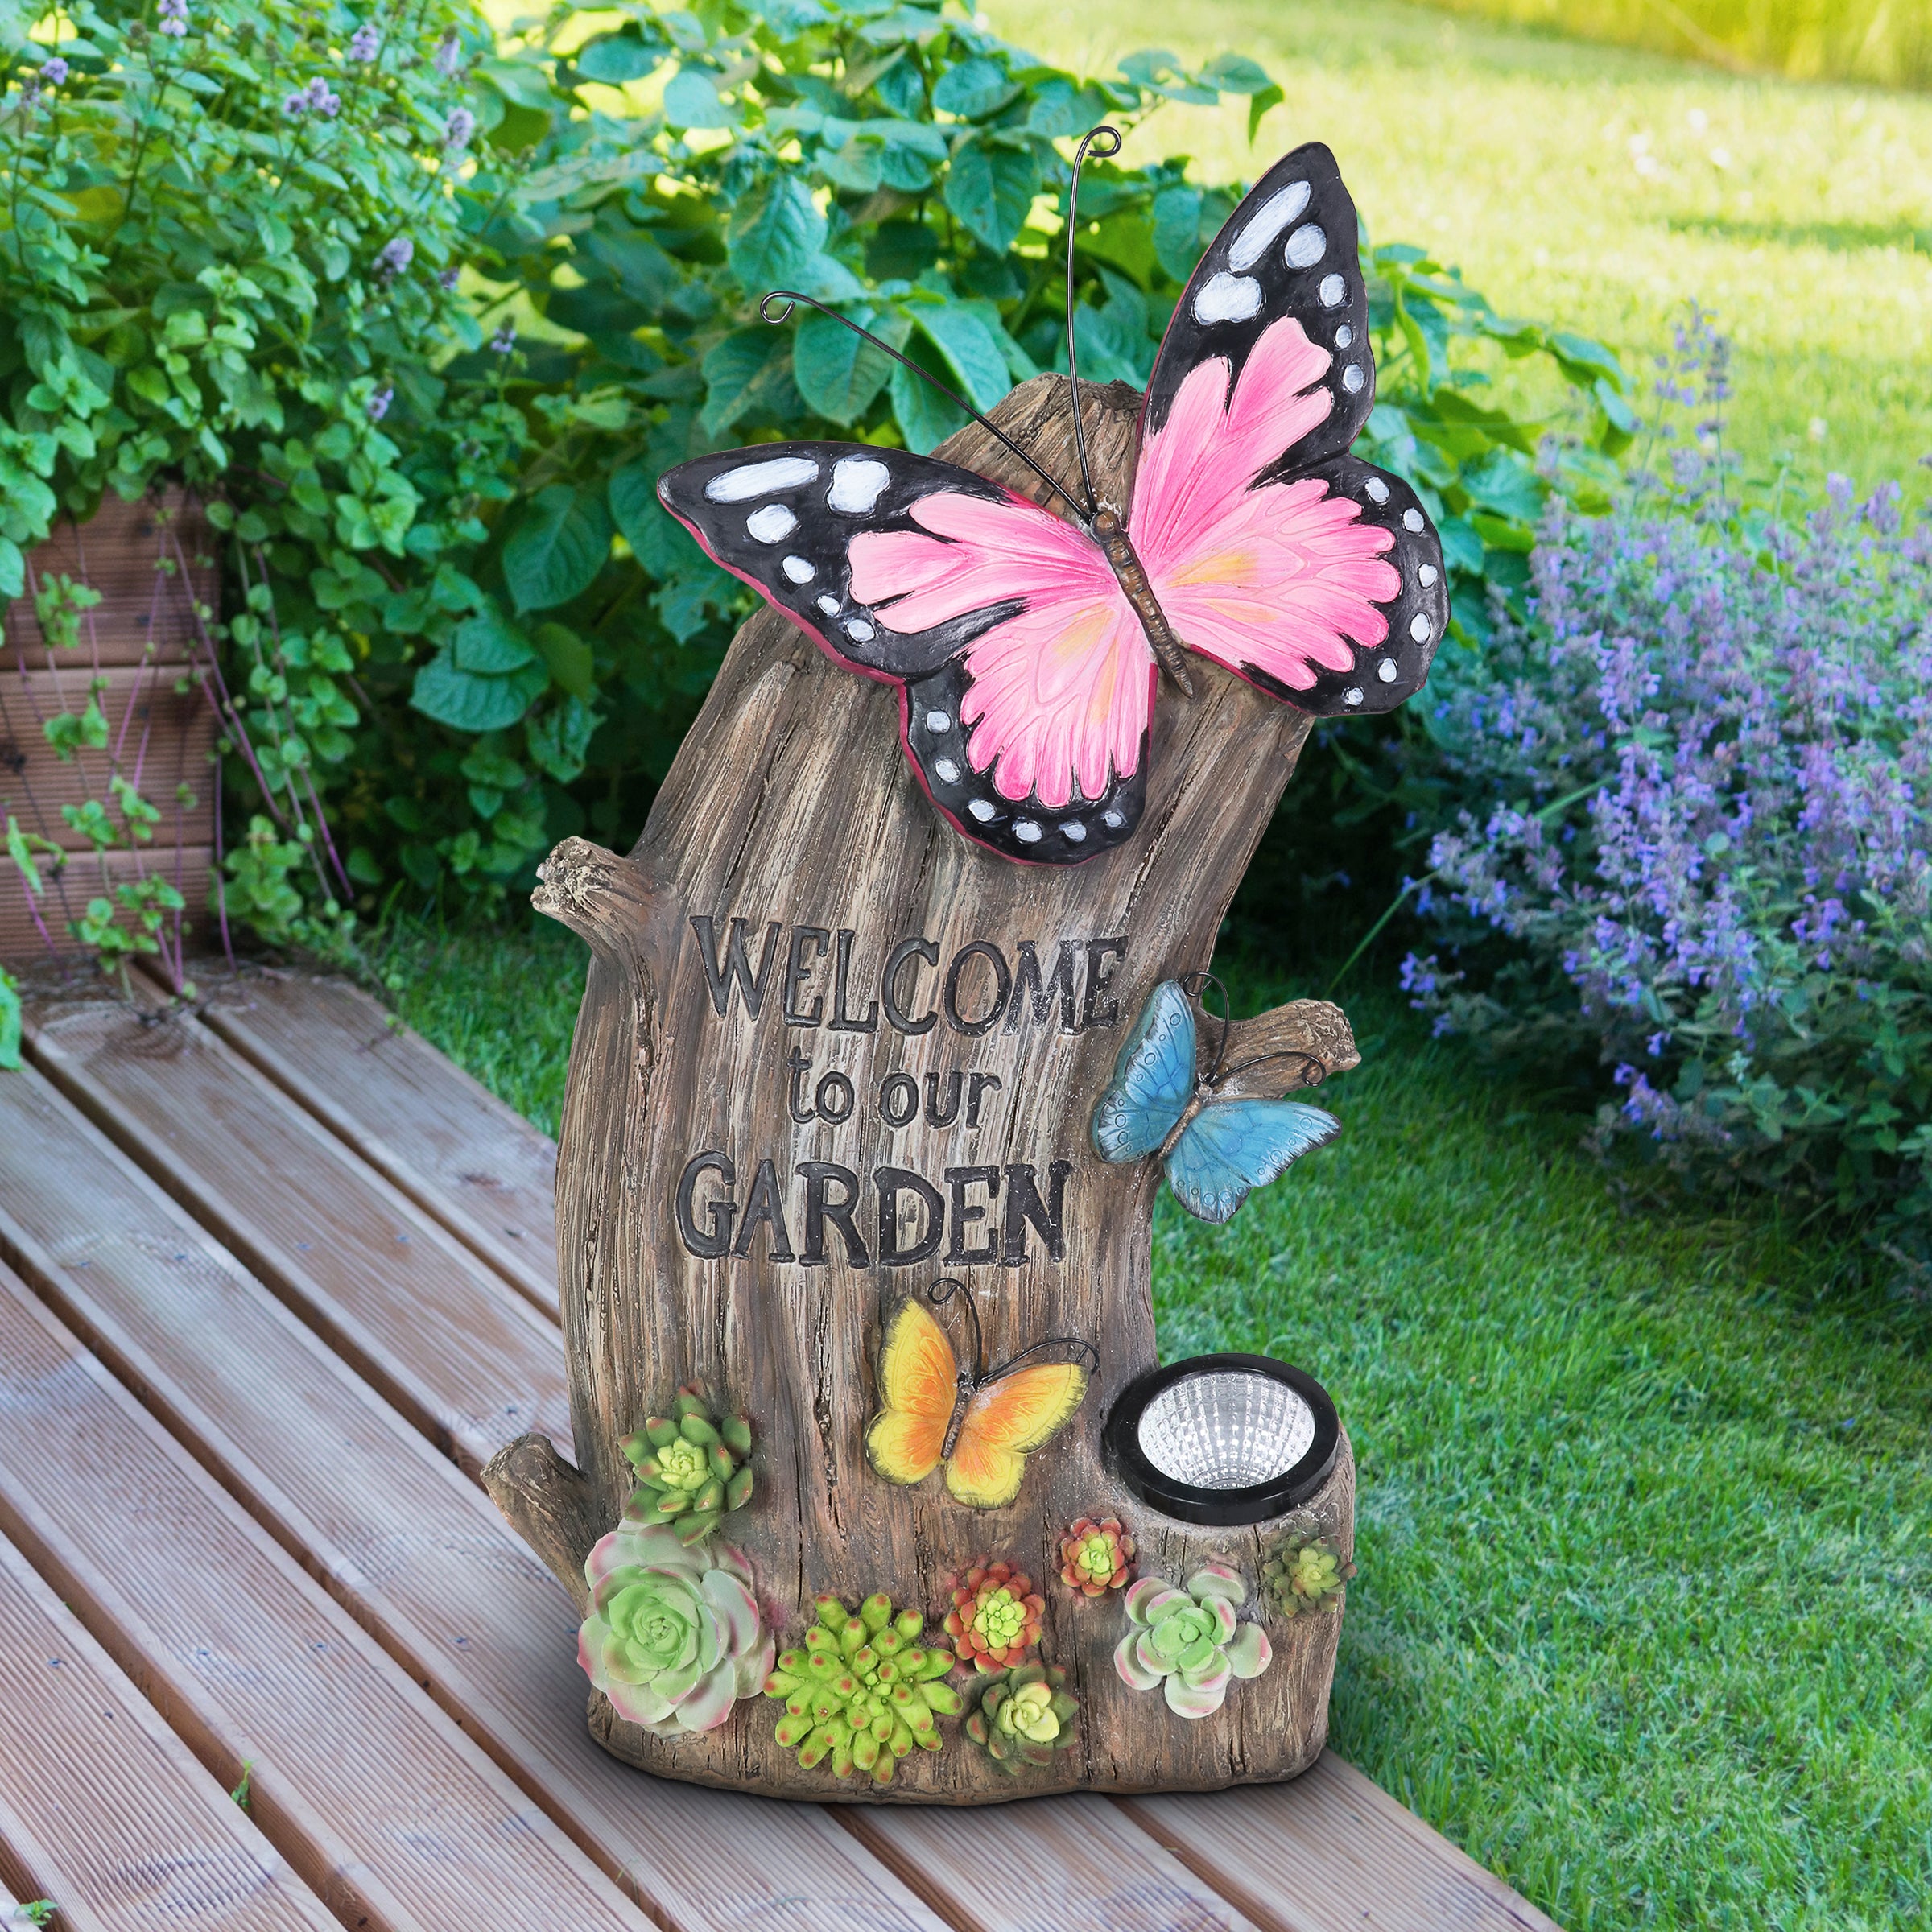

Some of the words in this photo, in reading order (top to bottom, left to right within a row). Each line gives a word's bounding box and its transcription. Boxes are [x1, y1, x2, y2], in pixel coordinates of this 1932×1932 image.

[690, 915, 1129, 1037] WELCOME
[788, 1046, 855, 1125] to
[880, 1071, 1002, 1129] our
[675, 1150, 1072, 1269] GARDEN
